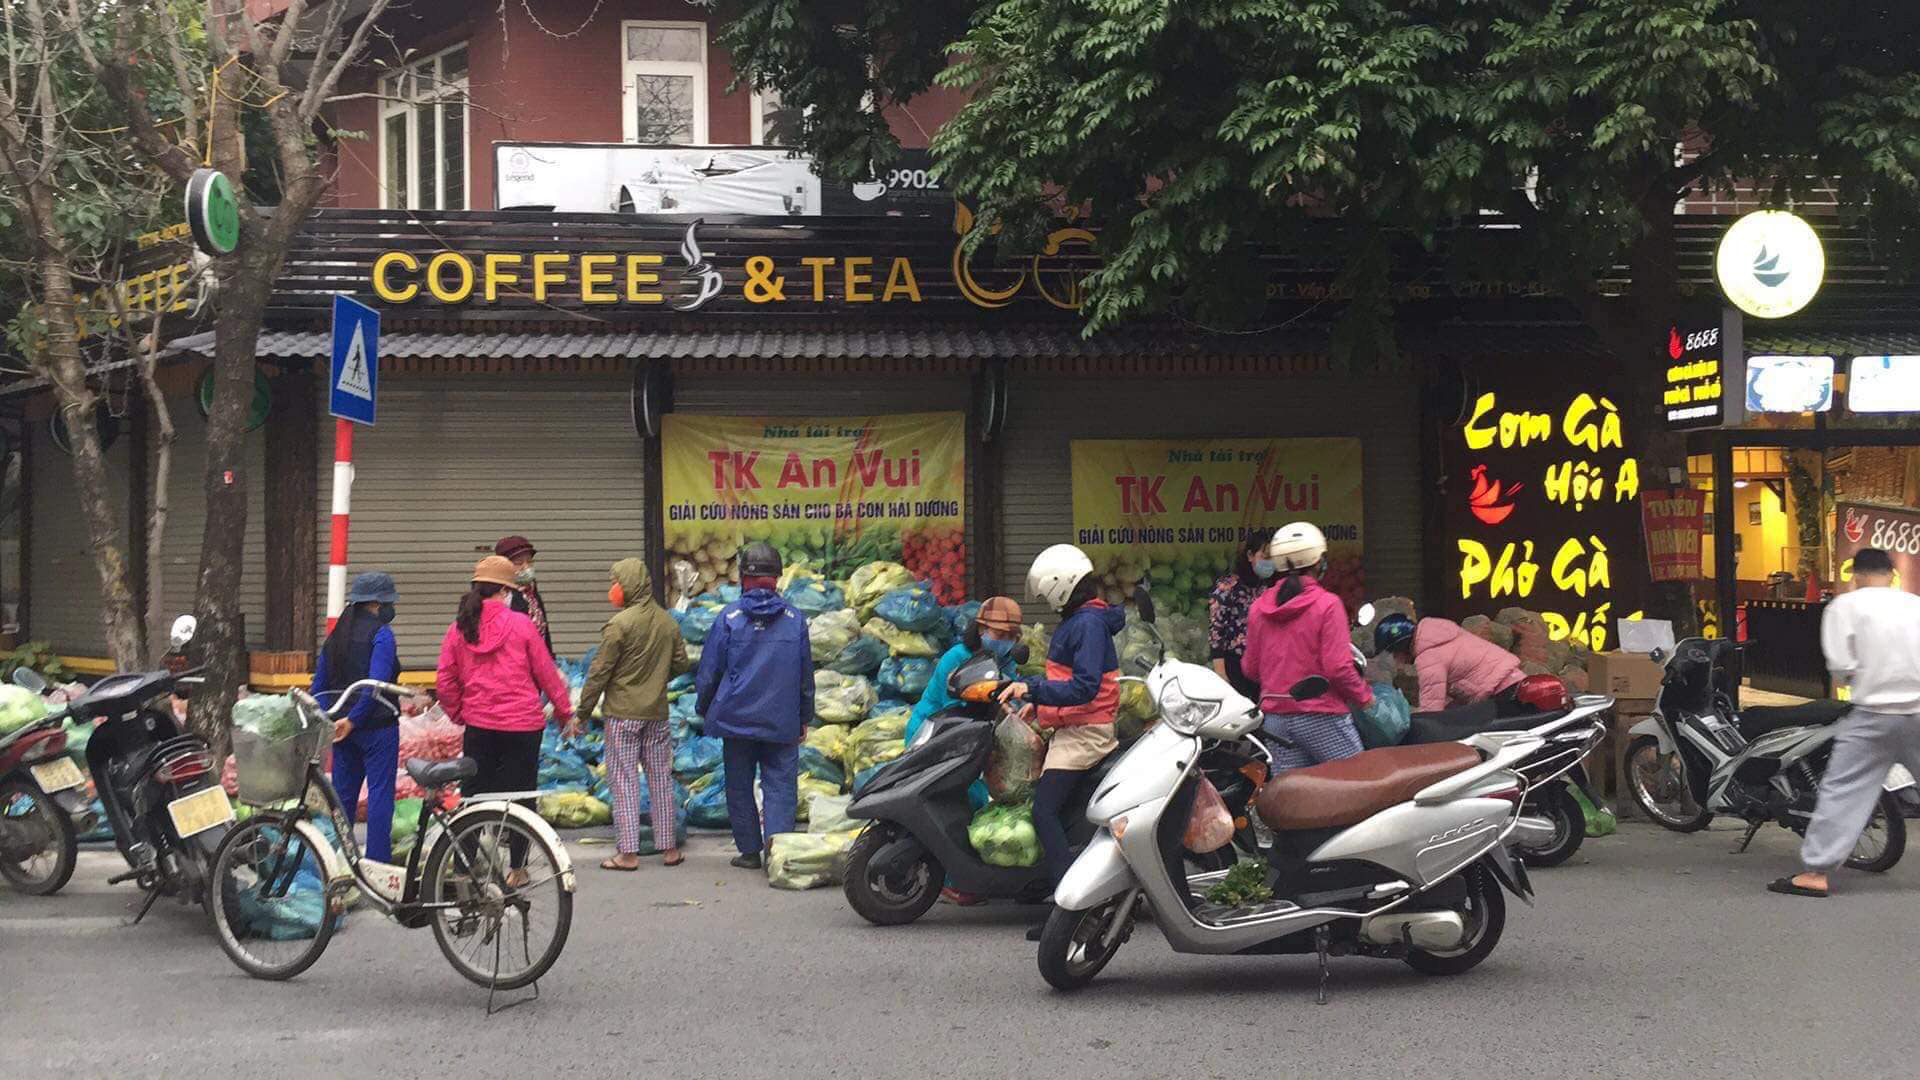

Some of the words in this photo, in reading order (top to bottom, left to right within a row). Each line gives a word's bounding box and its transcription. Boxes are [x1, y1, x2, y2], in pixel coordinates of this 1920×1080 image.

[886, 169, 939, 188] 9902
[373, 252, 662, 301] COFFEE
[743, 255, 786, 303] &
[802, 257, 922, 302] TEA
[1563, 393, 1623, 452] Gà
[708, 451, 761, 489] TK
[777, 451, 836, 489] An
[854, 449, 921, 488] Vui
[1544, 460, 1603, 512] Hội
[669, 500, 696, 521] GIẢI
[700, 501, 727, 520] CỨU
[731, 500, 768, 520] NÔNG
[773, 498, 800, 519] SẢN
[804, 503, 831, 519] CHO
[857, 502, 884, 518] CON
[888, 498, 910, 518] HẢI
[1115, 475, 1167, 514] TK
[1182, 475, 1239, 513] An
[1255, 473, 1320, 512] Vui
[1079, 523, 1104, 545] GIẢI
[1109, 525, 1134, 544] CỨU
[1138, 524, 1174, 544] NÔNG
[1178, 523, 1205, 543] SẢN
[1209, 527, 1233, 543] CHO
[1322, 524, 1357, 541] ƯƠNG
[1871, 519, 1920, 555] 8688
[1458, 538, 1540, 600] Phở
[1551, 535, 1611, 597] Gà
